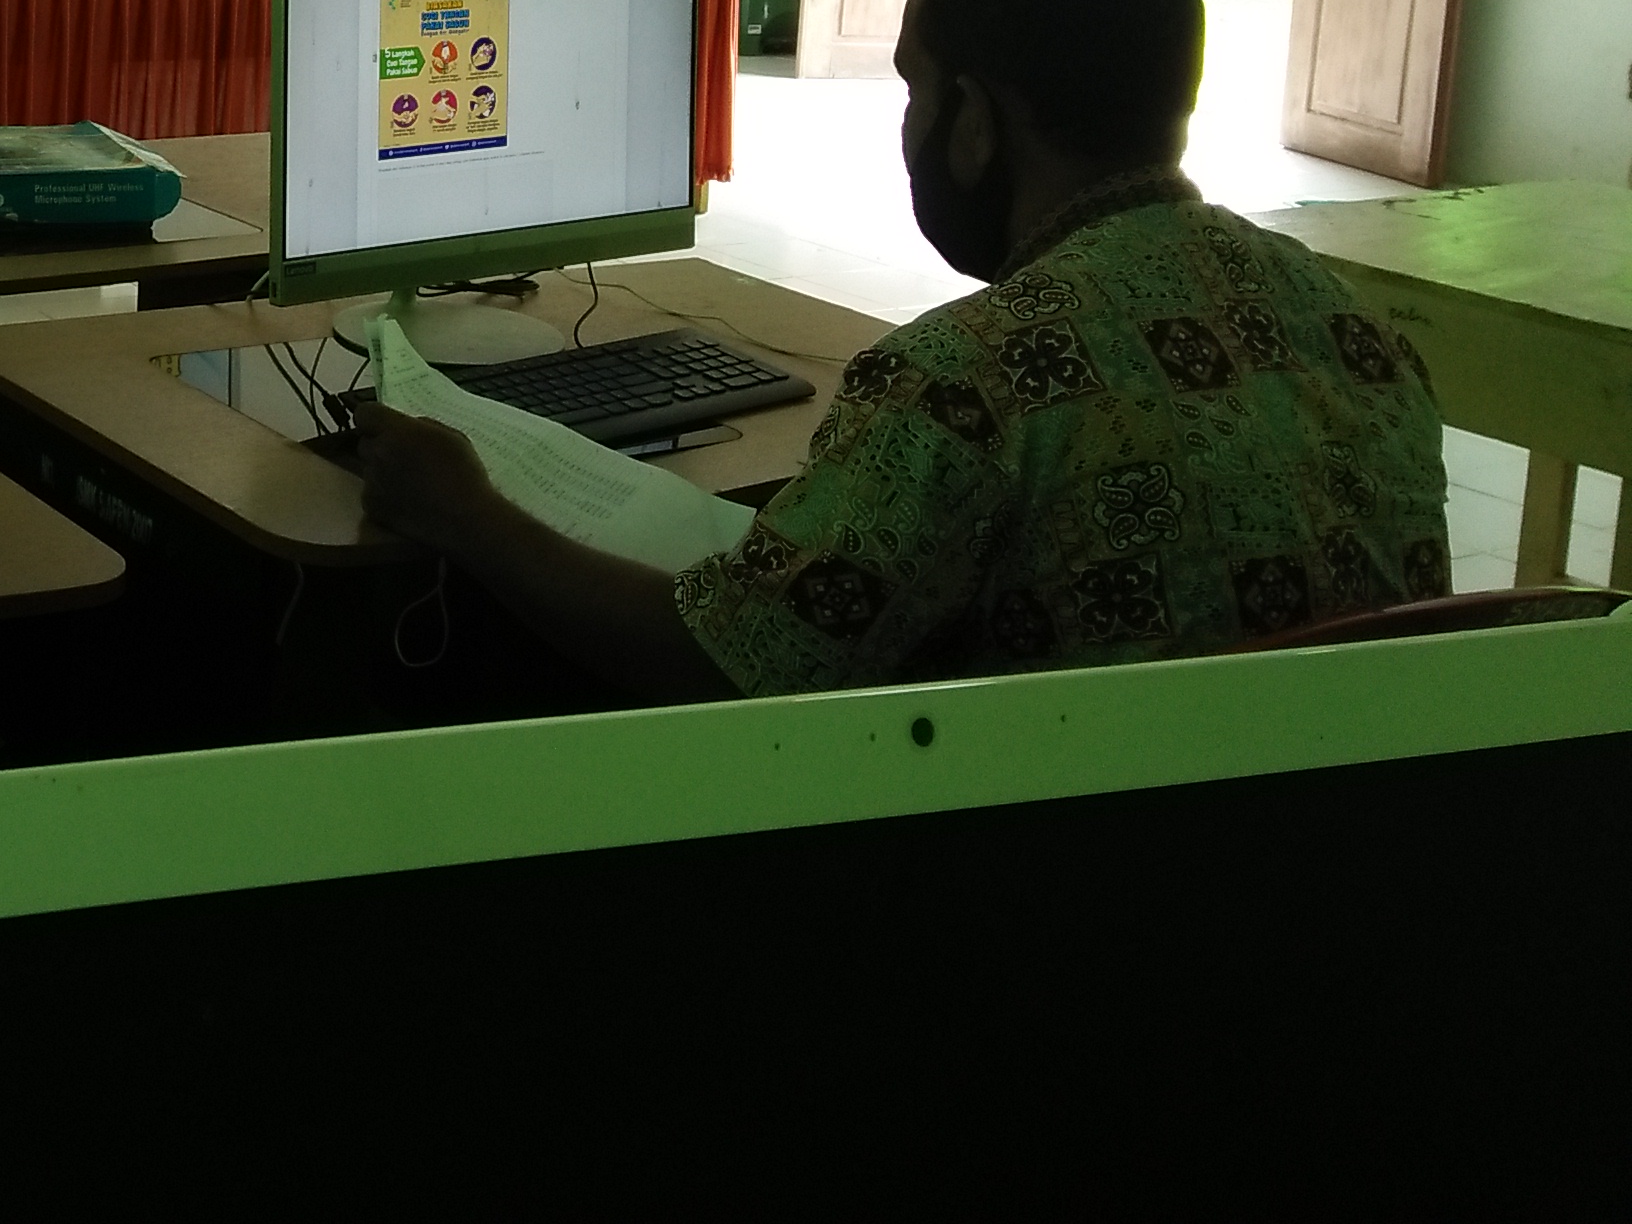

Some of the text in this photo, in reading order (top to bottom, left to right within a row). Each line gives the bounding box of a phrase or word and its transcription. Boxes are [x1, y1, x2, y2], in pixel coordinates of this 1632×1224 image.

[384, 48, 390, 57] 5
[34, 184, 86, 193] Professional
[107, 183, 144, 192] Wireless
[85, 194, 117, 204] System
